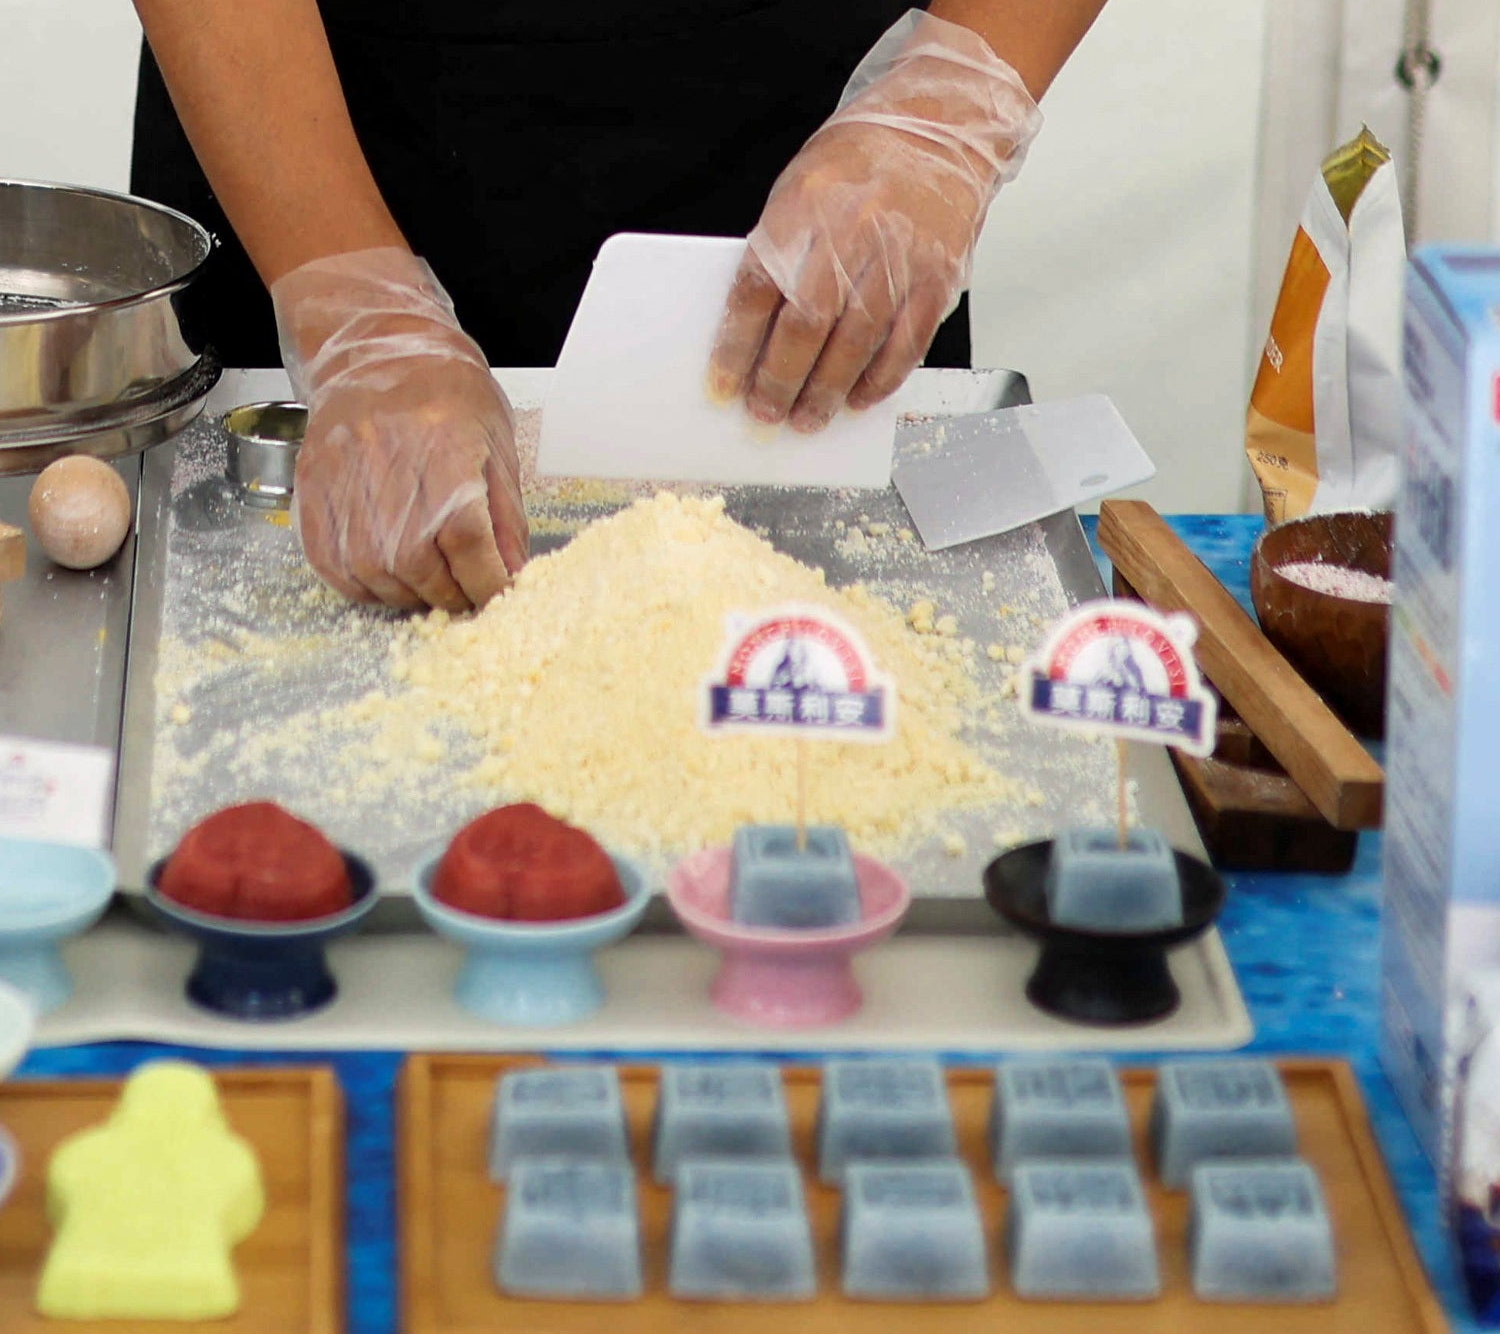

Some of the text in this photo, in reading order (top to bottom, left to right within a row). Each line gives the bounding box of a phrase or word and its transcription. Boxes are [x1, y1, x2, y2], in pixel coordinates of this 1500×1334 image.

[729, 693, 866, 726] 莫斯利安
[1052, 685, 1186, 732] 莫斯利安
